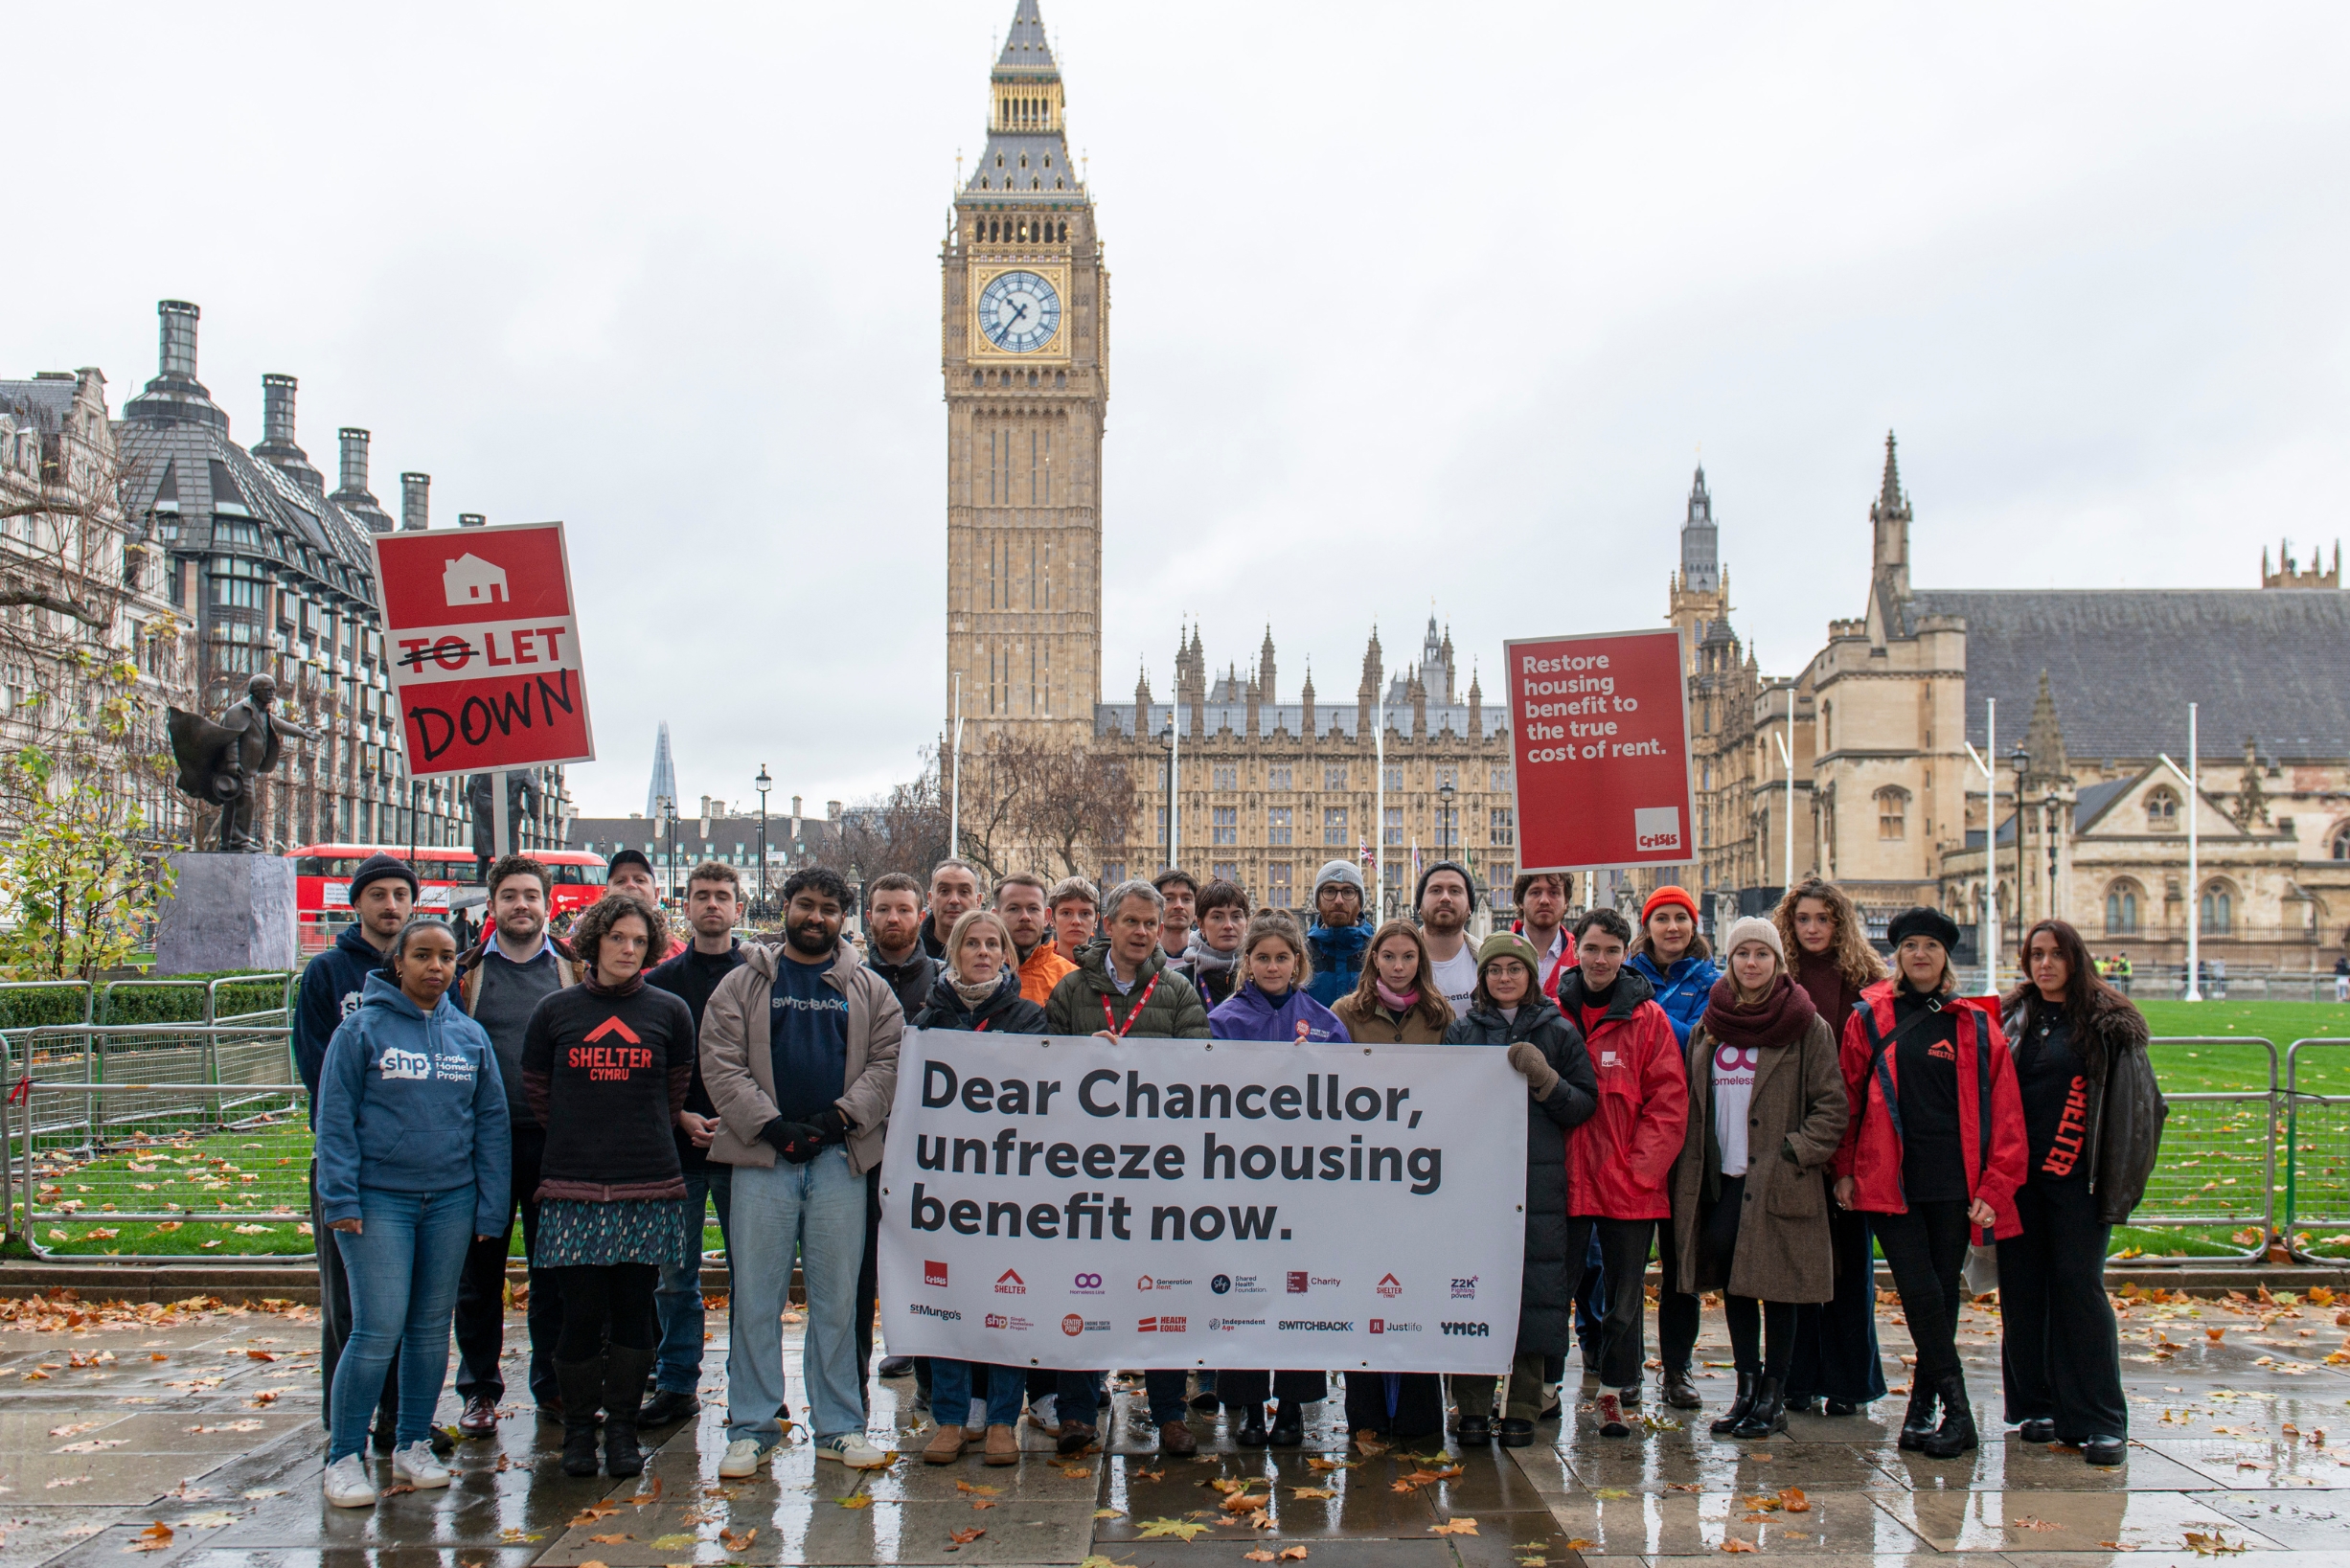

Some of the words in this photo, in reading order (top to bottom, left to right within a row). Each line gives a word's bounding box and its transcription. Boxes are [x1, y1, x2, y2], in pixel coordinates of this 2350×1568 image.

[399, 635, 470, 673] TO
[484, 626, 566, 667] LET
[1522, 655, 1609, 674] Restore
[1524, 674, 1614, 696] housing
[409, 668, 574, 761] DOWN
[1525, 696, 1607, 718] benefit
[1613, 696, 1638, 713] to
[1527, 723, 1564, 740] the
[1570, 720, 1618, 738] true
[1528, 743, 1576, 763] cost
[1582, 740, 1606, 760] of
[1612, 738, 1666, 757] rent.
[772, 996, 844, 1011] SWTCHBACK
[385, 1053, 426, 1075] shp
[568, 1047, 652, 1068] SHELTER
[1928, 1048, 1955, 1061] SHELTER
[436, 1071, 472, 1081] Project
[590, 1068, 629, 1080] CYMRU
[1712, 1076, 1755, 1086] omeless
[922, 1059, 1061, 1115] Dear
[1078, 1068, 1423, 1129] Chancellor,
[2042, 1075, 2088, 1177] SHELTER
[916, 1128, 1185, 1180] unfreeze
[1203, 1132, 1441, 1195] housing
[911, 1182, 1131, 1240] benefit
[1151, 1205, 1292, 1241] now.
[994, 1285, 1026, 1295] SHELTER
[1311, 1278, 1341, 1287] Charity
[1451, 1279, 1475, 1288] Z2K
[987, 1315, 1007, 1328] shp
[1387, 1323, 1422, 1331] Justlife
[1441, 1322, 1489, 1337] YMCA
